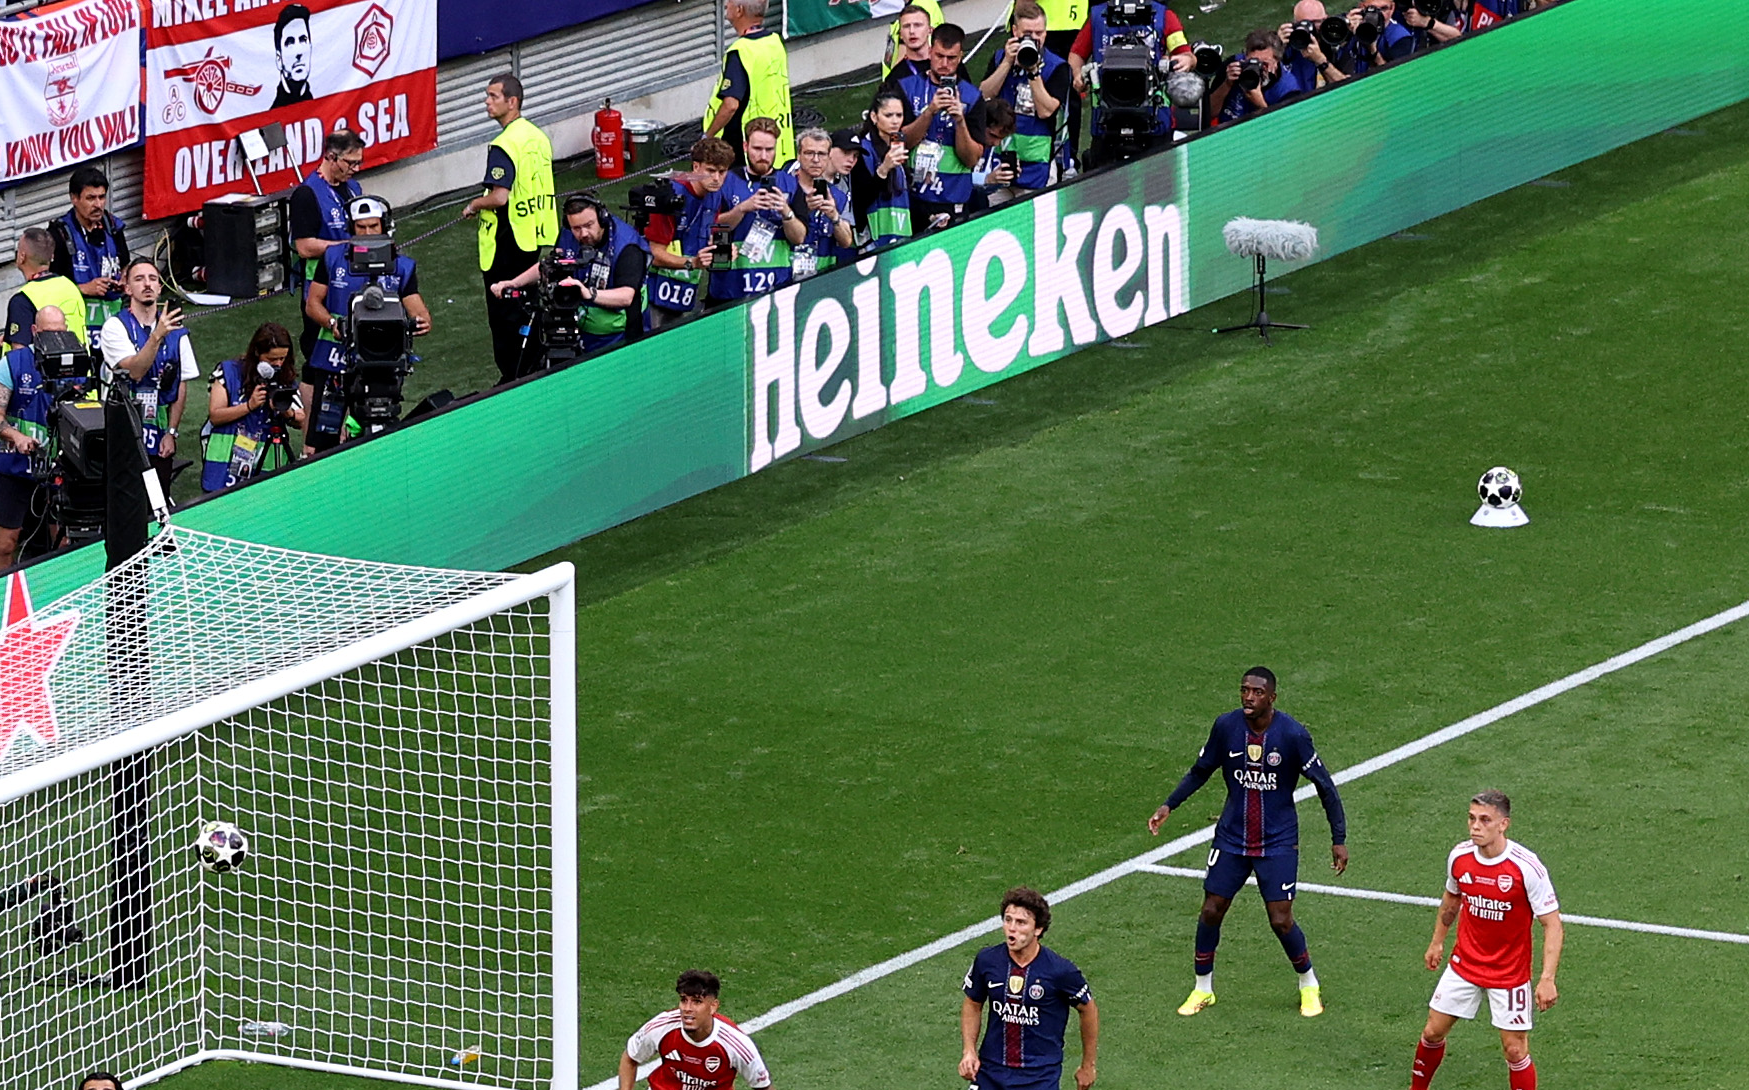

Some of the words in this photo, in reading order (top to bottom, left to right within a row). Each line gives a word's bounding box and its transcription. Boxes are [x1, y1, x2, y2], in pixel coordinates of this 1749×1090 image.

[357, 93, 411, 149] SEA
[5, 131, 55, 178] KNOW
[59, 119, 96, 162] YOU
[658, 281, 695, 307] 018
[749, 190, 1185, 475] Heineken
[1233, 769, 1278, 784] QATAR
[1479, 909, 1504, 921] BETTER
[992, 1000, 1039, 1017] QATAR
[1506, 988, 1526, 1012] 19
[1001, 1014, 1040, 1026] AIRWAYS
